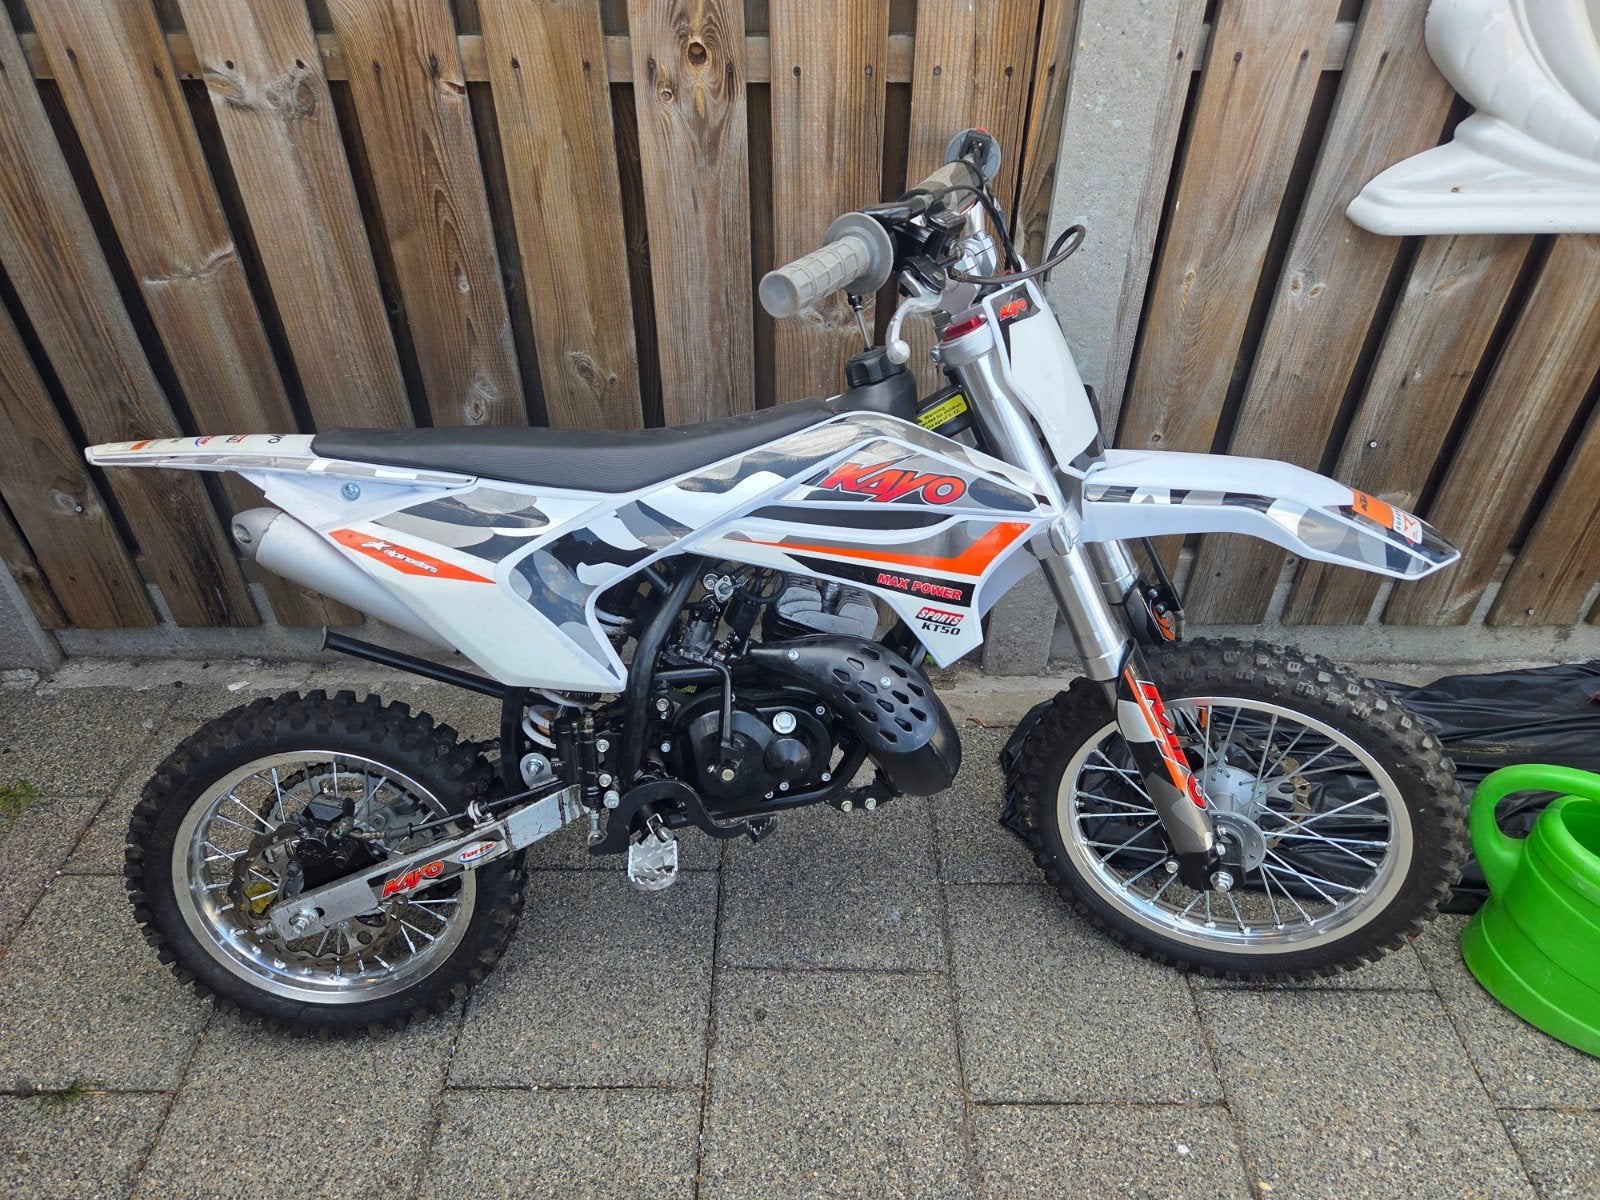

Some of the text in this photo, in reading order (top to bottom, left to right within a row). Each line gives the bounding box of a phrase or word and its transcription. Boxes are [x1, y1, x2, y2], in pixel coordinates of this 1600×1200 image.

[818, 458, 967, 505] KAYO
[877, 573, 963, 601] MAX POWER
[917, 608, 963, 626] SPORTS
[920, 621, 962, 636] KT50
[461, 842, 494, 858] Torco
[382, 860, 444, 899] KAYO
